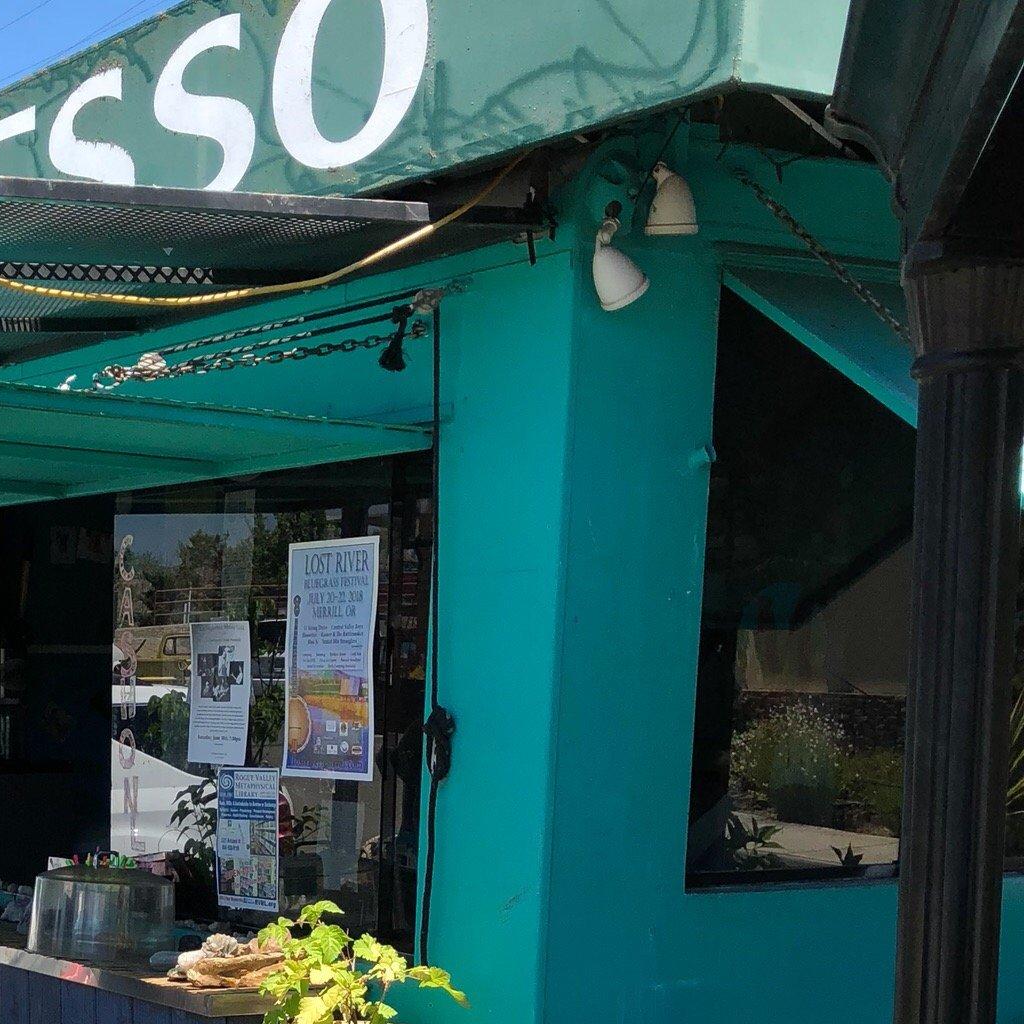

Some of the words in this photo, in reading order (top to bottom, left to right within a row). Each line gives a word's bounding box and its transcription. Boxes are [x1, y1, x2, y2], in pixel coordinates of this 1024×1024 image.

[305, 552, 333, 575] LOST
[336, 549, 369, 573] RIVER
[304, 577, 339, 589] BLUEGRASS
[340, 575, 369, 587] FESTIVAL
[308, 591, 325, 605] JULY
[348, 589, 363, 602] 2018
